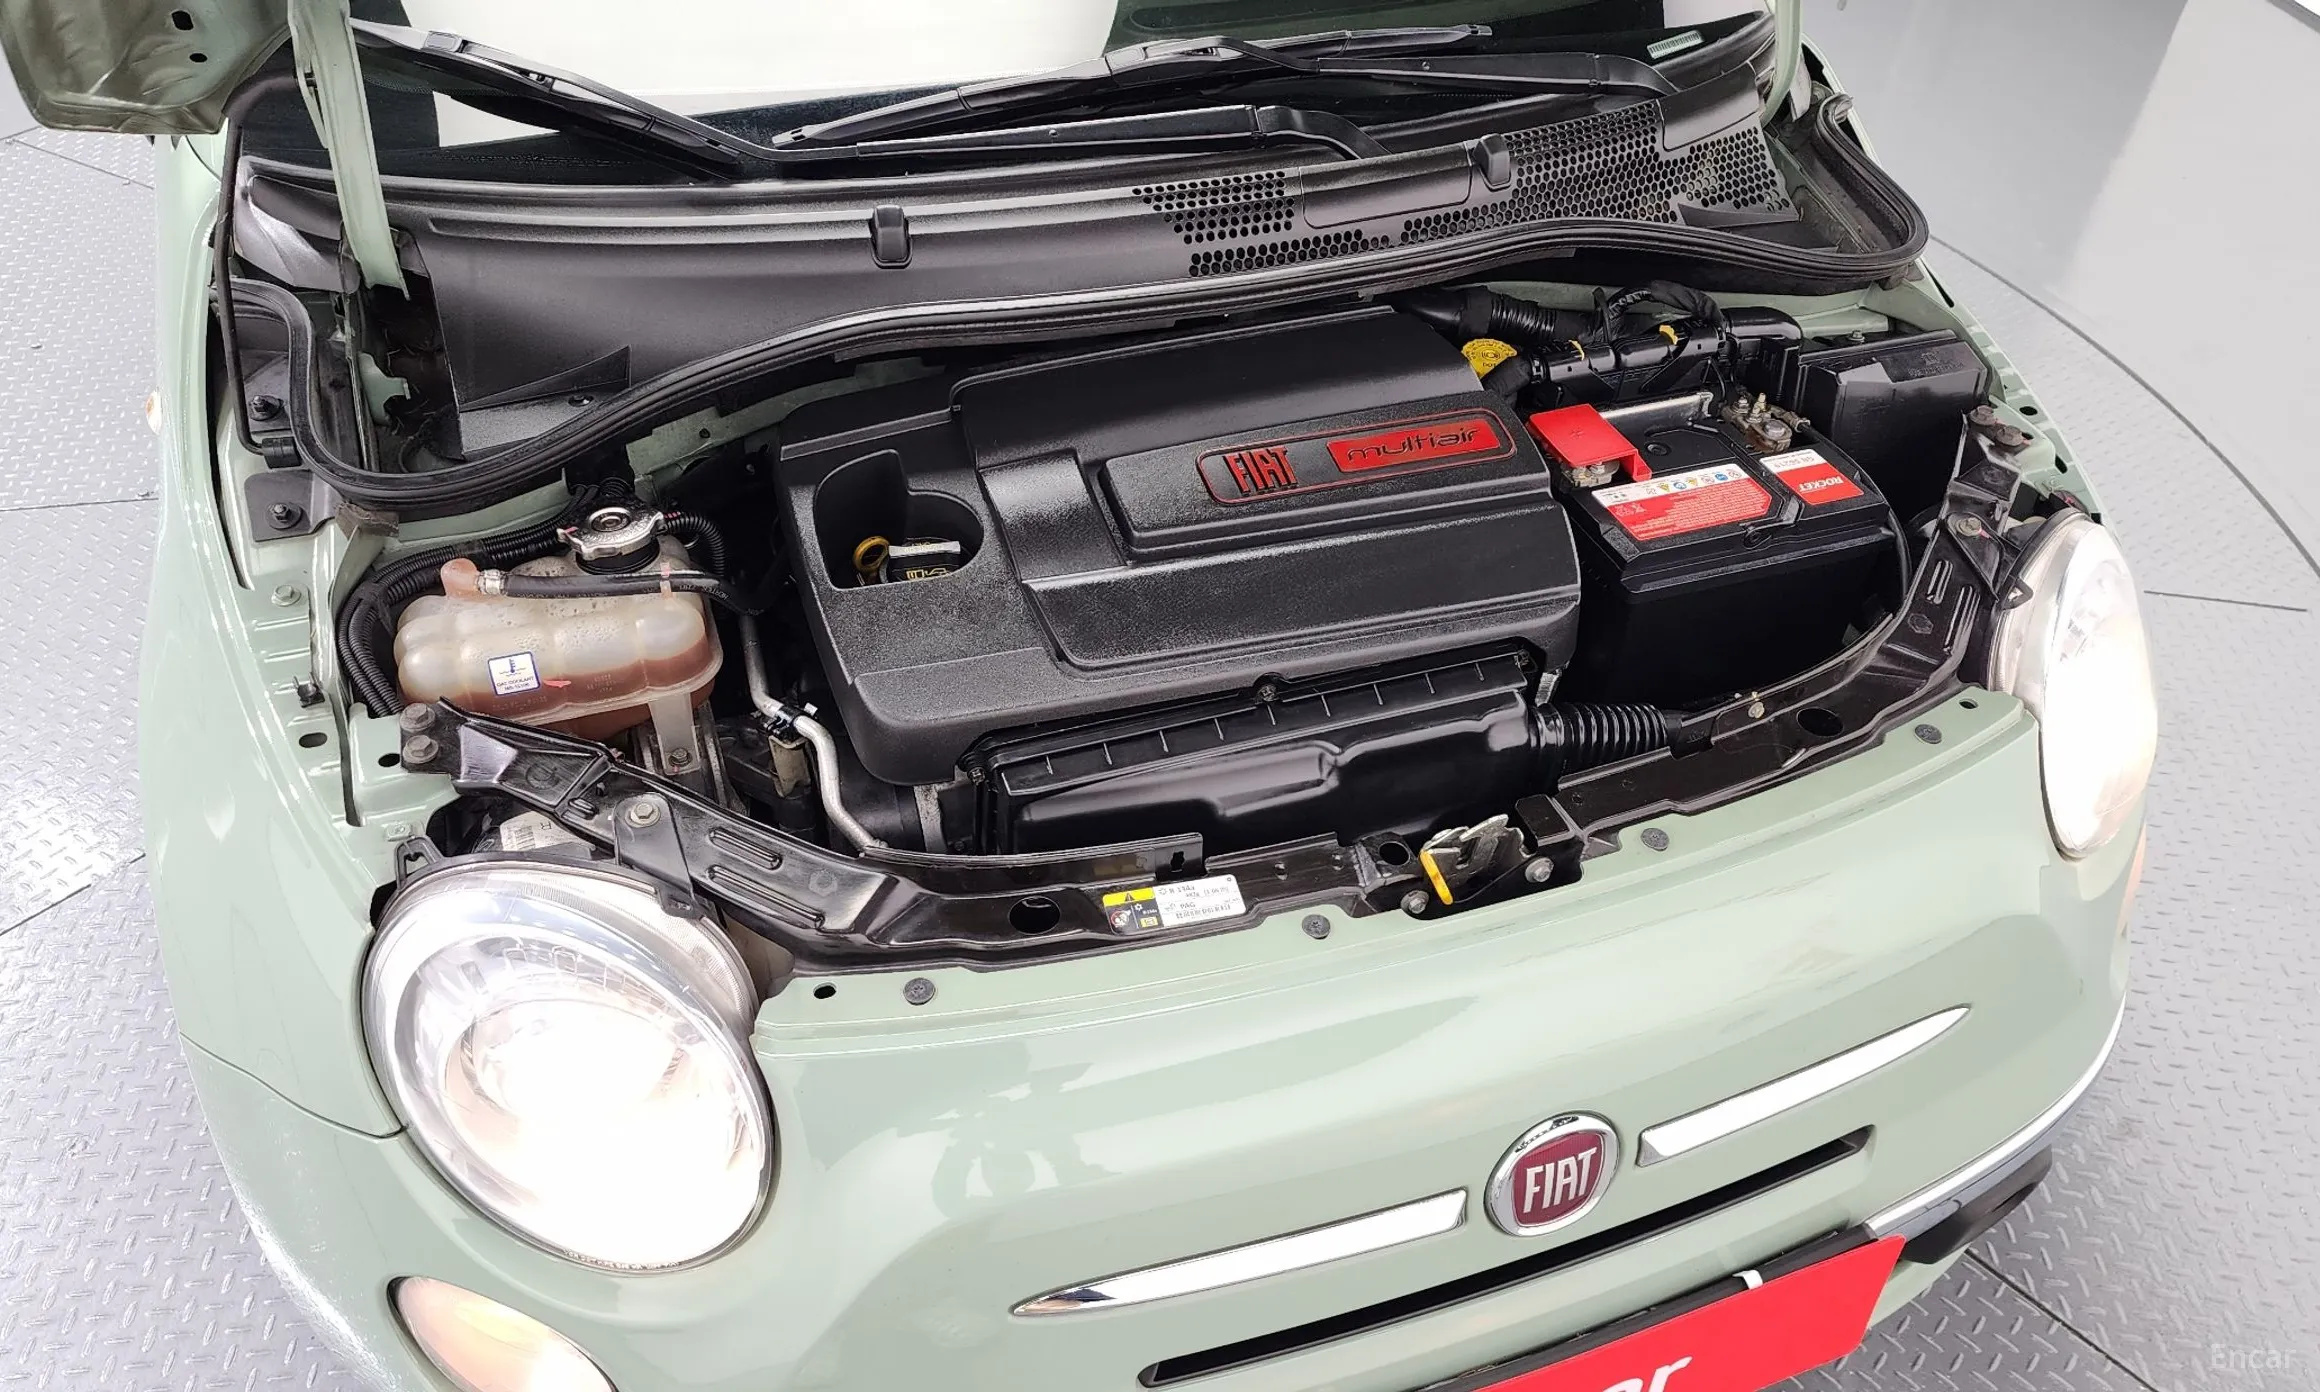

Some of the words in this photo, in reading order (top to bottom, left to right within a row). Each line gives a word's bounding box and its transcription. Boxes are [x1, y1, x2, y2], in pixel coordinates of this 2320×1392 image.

[1222, 445, 1298, 496] FIAT
[1347, 426, 1480, 461] multiair
[1799, 475, 1844, 493] ROCKET
[1522, 1146, 1598, 1214] FIAT
